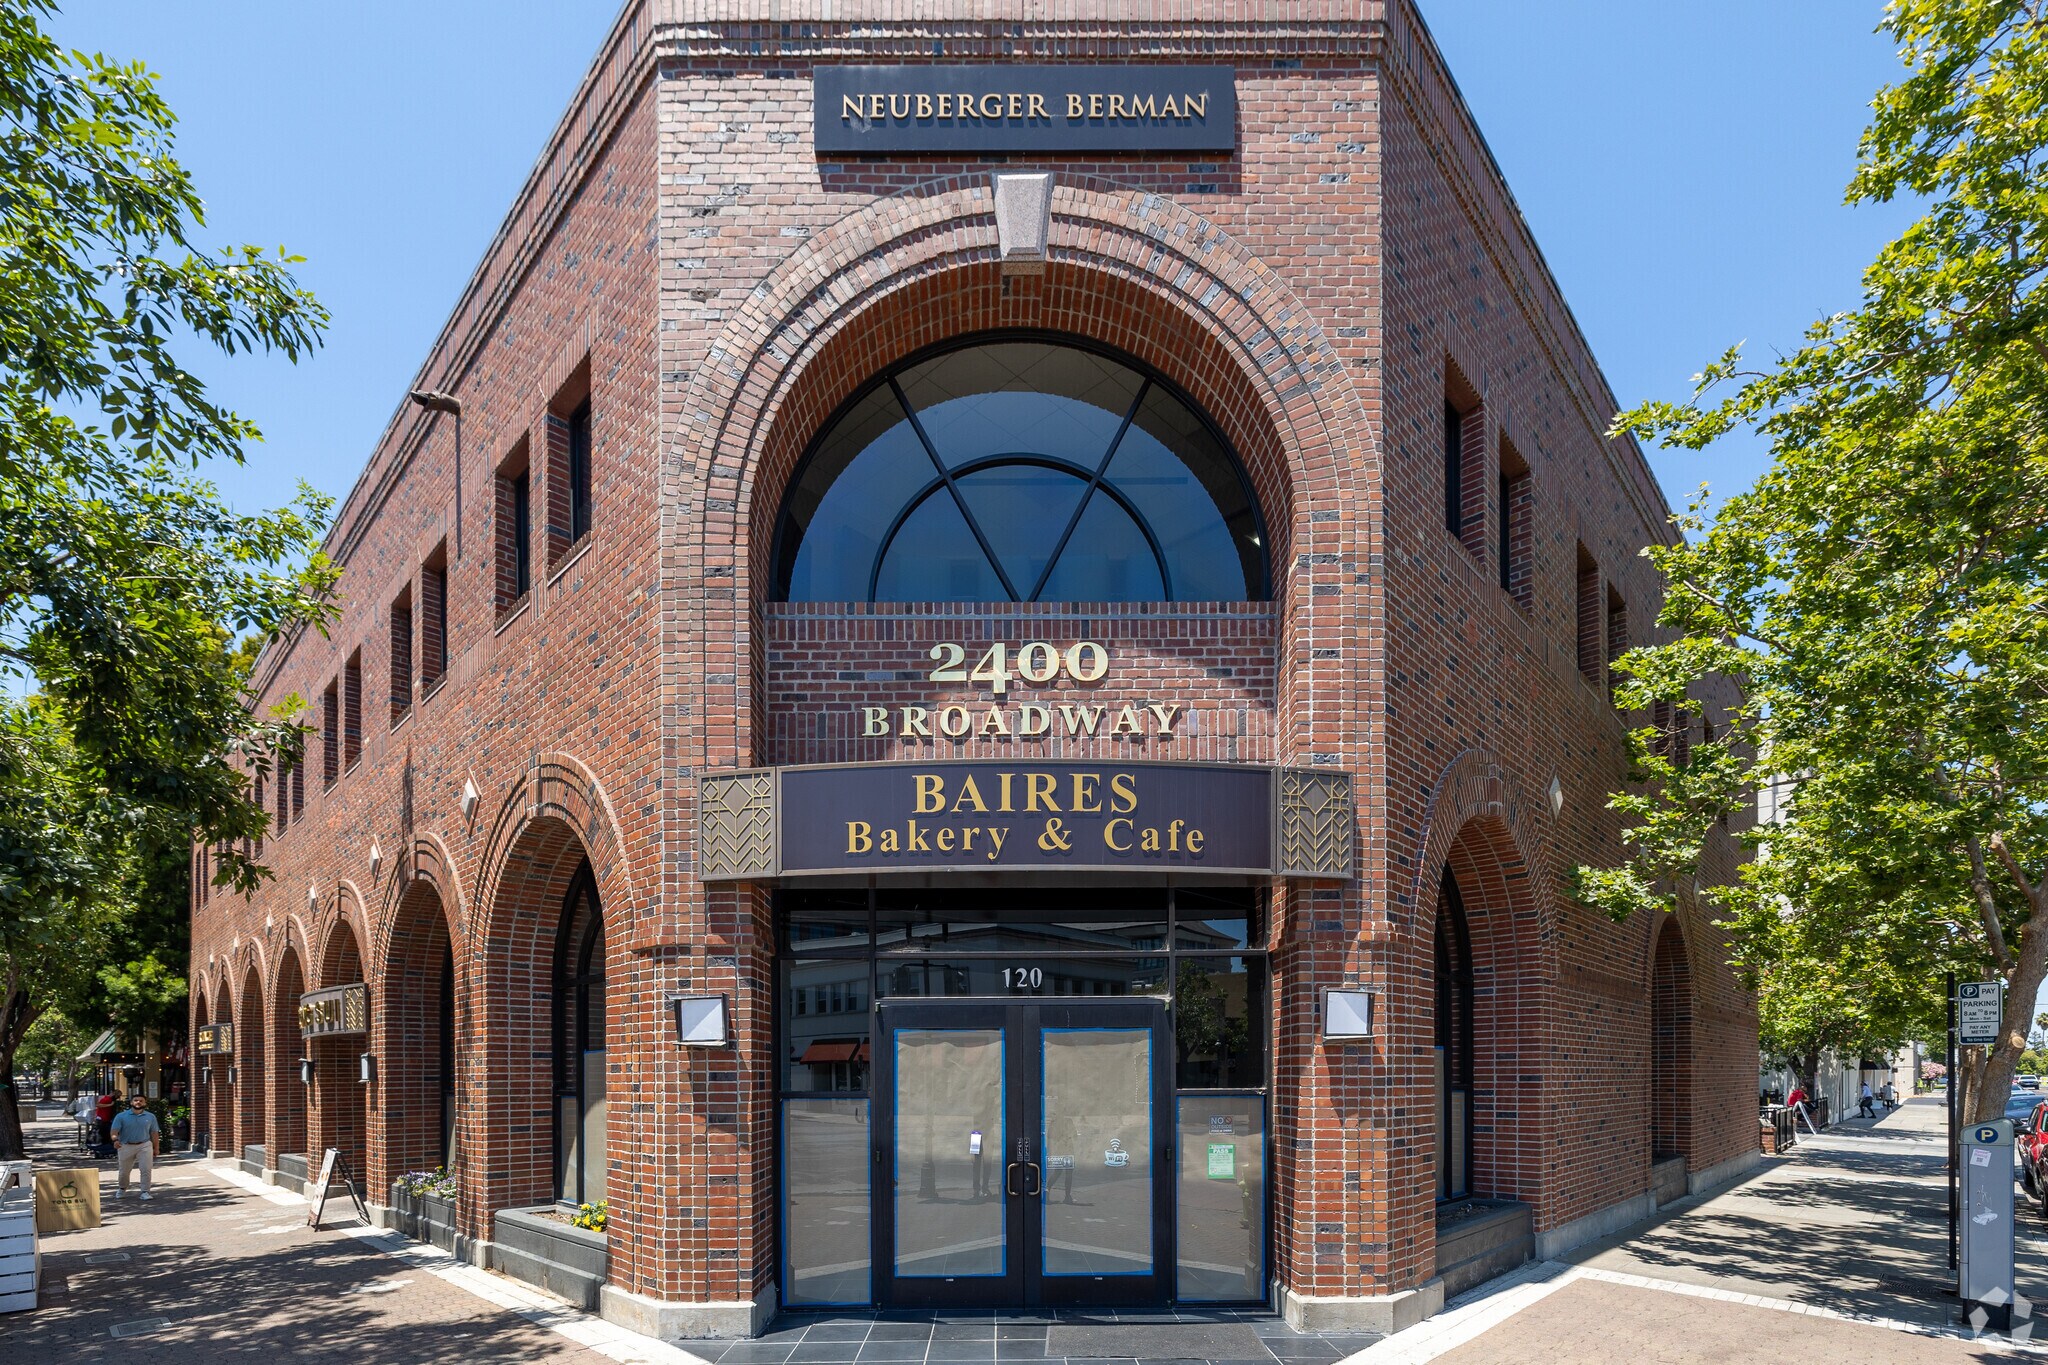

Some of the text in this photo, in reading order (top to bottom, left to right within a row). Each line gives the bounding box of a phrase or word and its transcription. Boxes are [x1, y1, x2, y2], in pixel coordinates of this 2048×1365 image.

[841, 94, 1207, 119] NEUBERGER BERMAN
[929, 642, 1109, 694] 2400
[861, 704, 1181, 737] BROADWAY
[912, 773, 1139, 814] BAIRES
[845, 817, 1205, 860] Bakery & Cafe
[1001, 967, 1043, 988] 120
[315, 999, 340, 1025] SUI
[1211, 1117, 1224, 1125] NO
[1981, 1130, 1994, 1140] P
